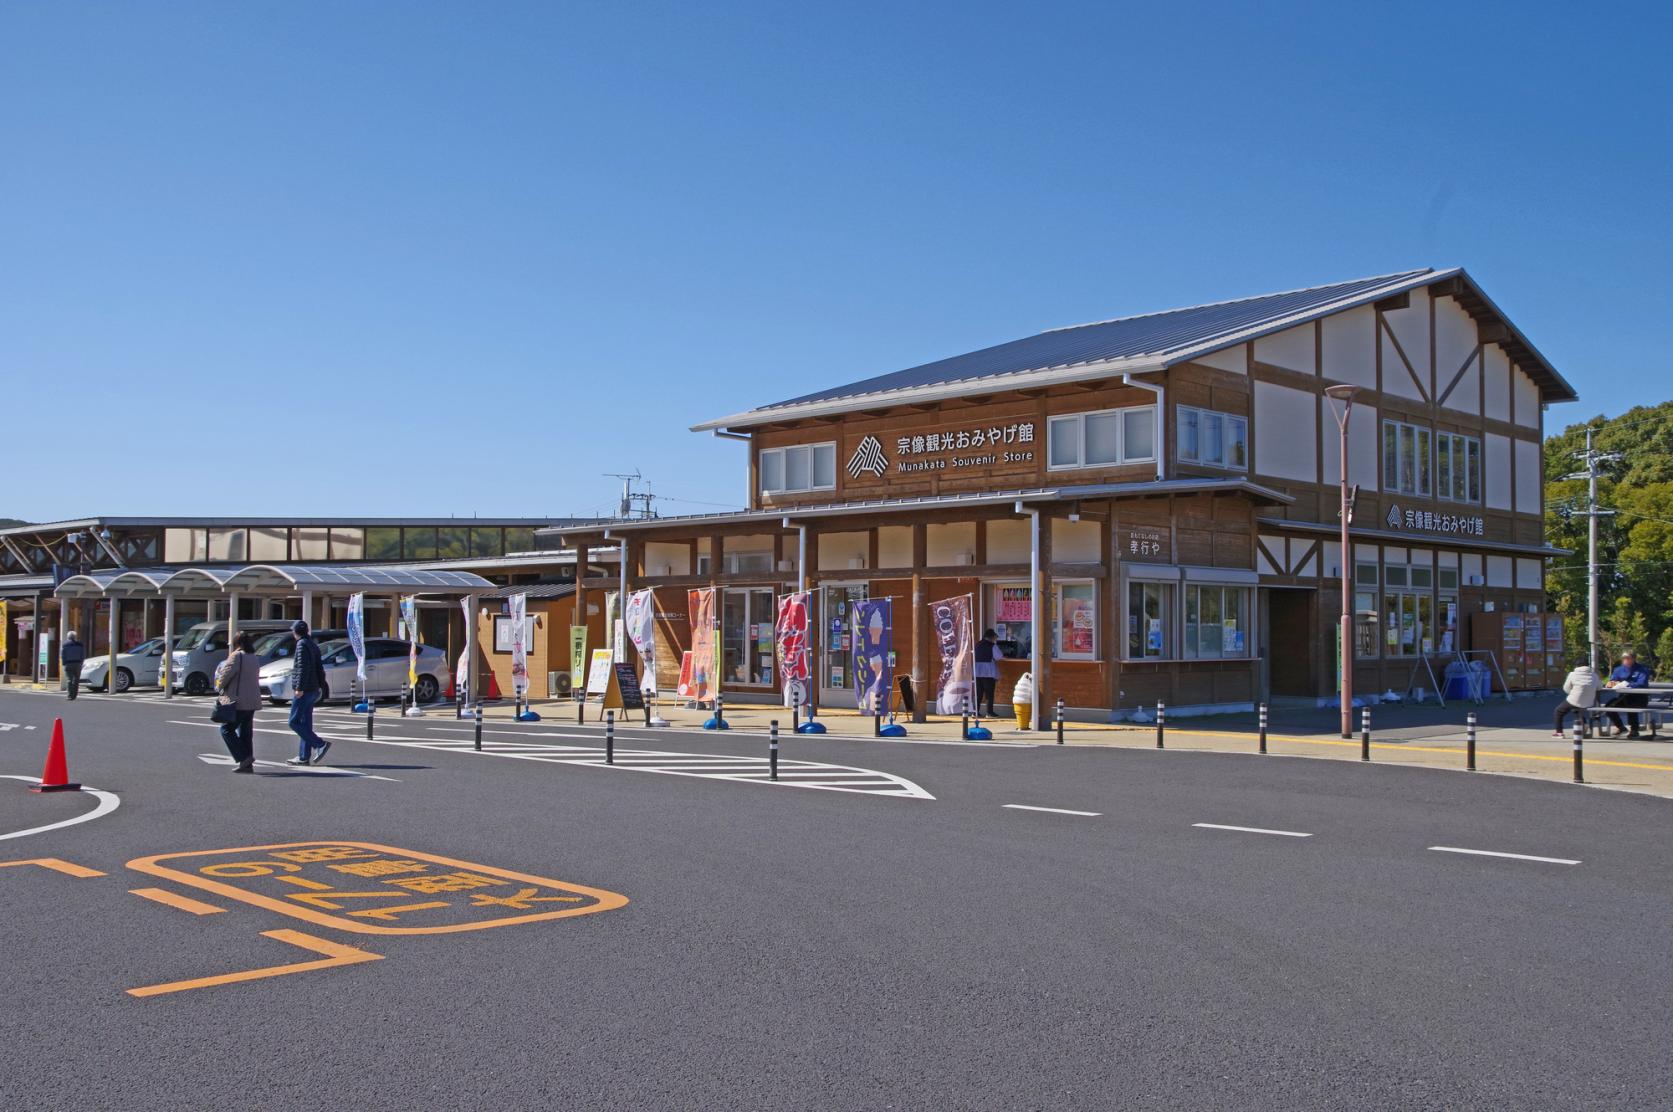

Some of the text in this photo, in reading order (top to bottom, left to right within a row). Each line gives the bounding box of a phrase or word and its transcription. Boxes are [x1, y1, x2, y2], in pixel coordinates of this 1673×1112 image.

[897, 423, 1034, 455] 宗像観光おみやげ館
[898, 451, 1033, 473] Munakata Souvenir Store
[1405, 509, 1485, 536] 宗像観光おみやげ館
[1130, 540, 1160, 556] 孝行や
